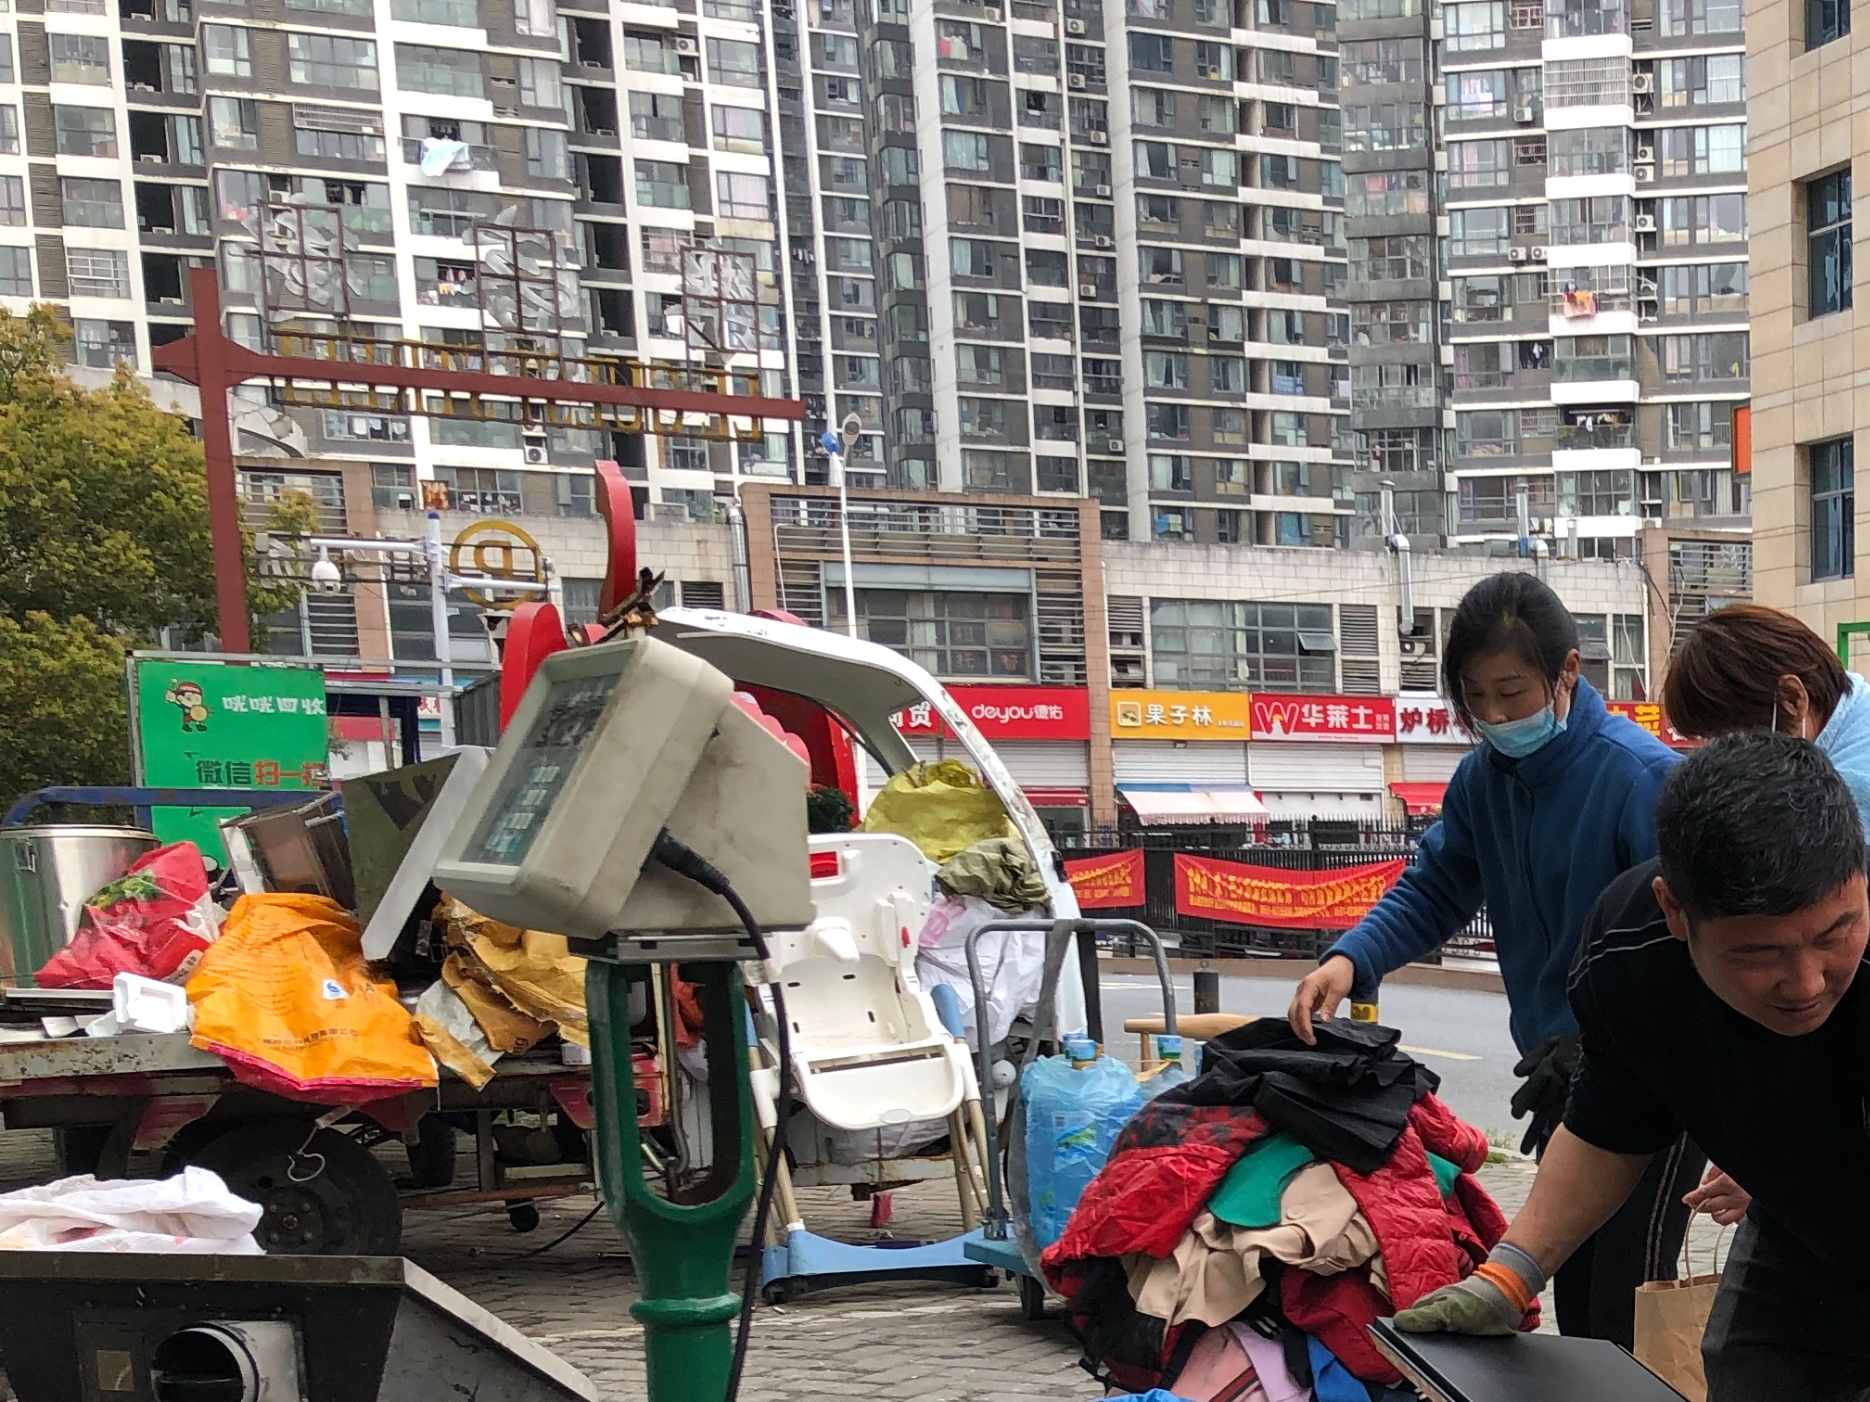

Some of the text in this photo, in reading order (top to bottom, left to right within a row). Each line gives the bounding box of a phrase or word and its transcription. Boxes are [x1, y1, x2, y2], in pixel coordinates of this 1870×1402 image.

[222, 694, 327, 715] 咣咣回收
[971, 703, 1063, 724] deyou 德佑
[1145, 703, 1214, 727] 果子林
[1301, 703, 1374, 730] 华莱士
